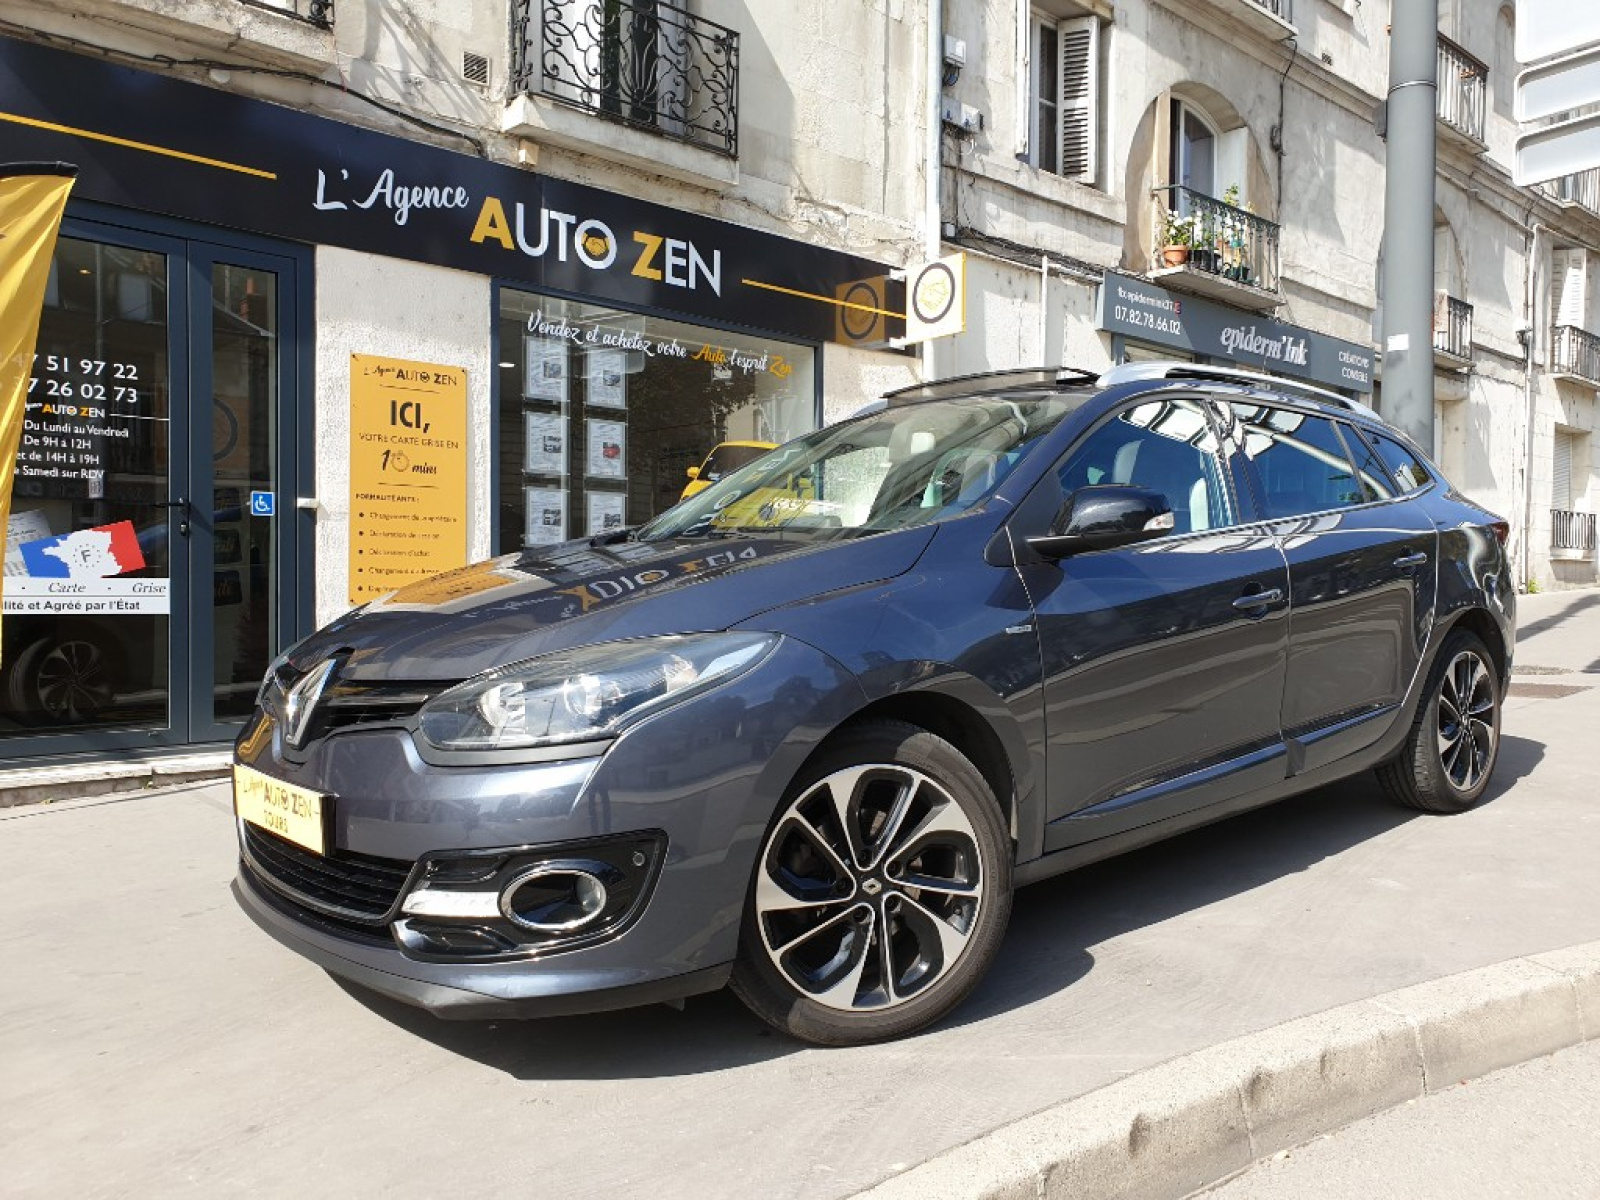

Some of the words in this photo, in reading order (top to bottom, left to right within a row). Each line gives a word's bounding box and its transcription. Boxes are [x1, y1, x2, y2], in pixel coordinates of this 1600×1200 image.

[470, 196, 618, 269] AUTO
[631, 231, 721, 297] ZEN
[1115, 305, 1181, 334] 07.82.78.66.02
[528, 309, 583, 344] Vendez
[586, 325, 599, 342] et
[603, 330, 655, 356] achetez
[657, 339, 687, 357] votre
[691, 343, 726, 363] Auto
[769, 354, 793, 378] Zen
[1220, 326, 1309, 366] epiderm'Ink
[46, 355, 69, 372] 51
[80, 359, 106, 376] 97
[113, 363, 138, 380] 22
[396, 368, 431, 384] AUTO
[433, 373, 458, 386] ZEN
[46, 379, 73, 397] 26
[80, 383, 106, 400] 02
[113, 386, 138, 403] 73
[42, 404, 78, 416] AUTO
[79, 407, 106, 418] ZEN
[390, 400, 431, 434] ICI,
[24, 420, 40, 431] Du
[43, 421, 71, 434] Lundi
[74, 426, 85, 434] au
[86, 424, 129, 438] Vendredi
[24, 435, 40, 446] De
[42, 436, 59, 448] 9H
[71, 438, 92, 449] 12H
[359, 432, 388, 443] VOTRE
[390, 435, 420, 446] CARTE
[421, 438, 445, 448] GRISE
[446, 441, 459, 449] EN
[29, 450, 42, 462] de
[46, 451, 67, 463] 14H
[79, 453, 100, 465] 19H
[22, 465, 59, 477] Samedi
[62, 469, 79, 478] sur
[48, 582, 87, 593] Carte
[132, 581, 167, 593] Grise
[4, 600, 24, 610] lité
[28, 600, 41, 610] et
[43, 600, 82, 612] Agréé
[85, 602, 106, 613] par
[109, 598, 140, 610] l'État
